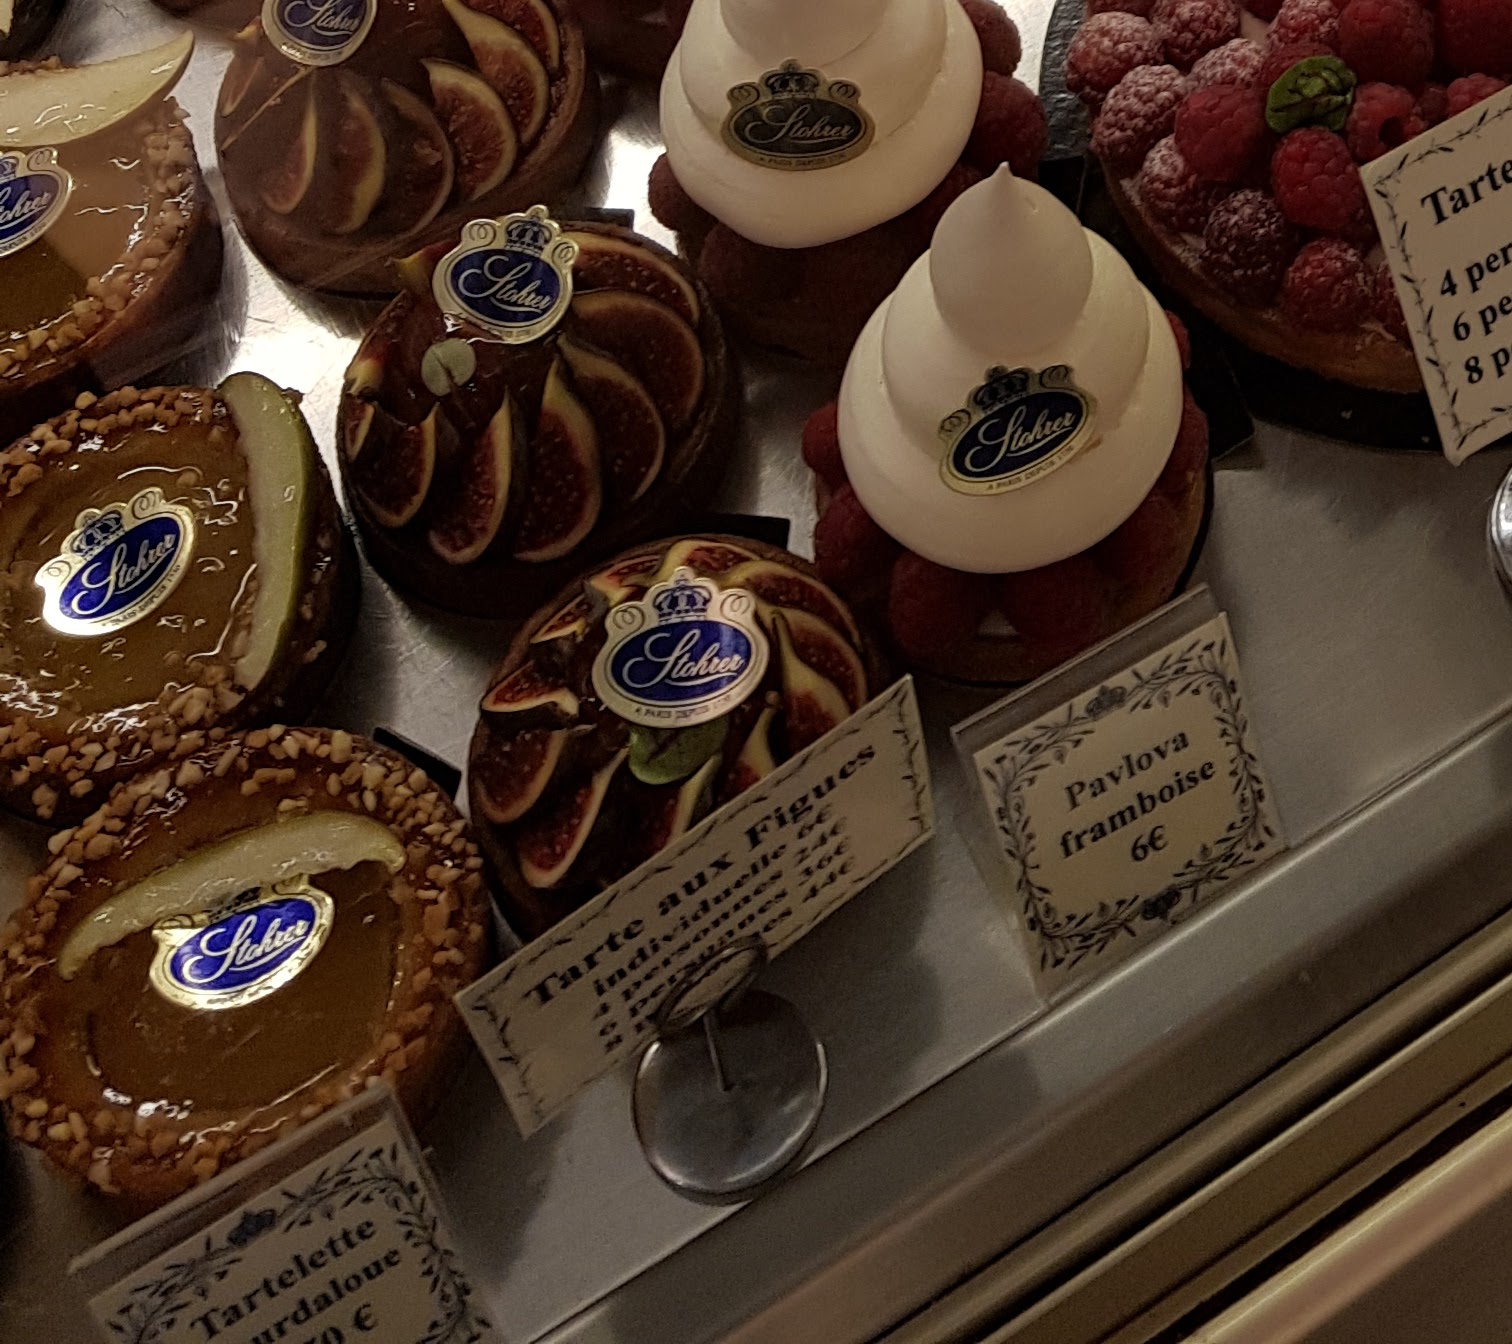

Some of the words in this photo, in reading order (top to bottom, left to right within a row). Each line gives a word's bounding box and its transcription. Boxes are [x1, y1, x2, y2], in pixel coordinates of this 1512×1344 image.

[743, 103, 855, 146] Stohrer
[0, 186, 52, 231] ohrer
[458, 254, 553, 314] Stohrer
[1440, 269, 1457, 297] 4
[1453, 311, 1471, 342] 6
[1464, 355, 1484, 385] 8
[965, 405, 1077, 473] Stohrer
[72, 532, 176, 616] Stohrer
[622, 629, 745, 688] Stohrer
[1064, 731, 1190, 812] Pavlova
[1060, 761, 1216, 860] framboise
[522, 918, 645, 1006] Tarte
[657, 851, 736, 916] aux
[744, 744, 876, 852] Figues
[1130, 824, 1169, 862] 6€
[182, 914, 312, 984] Stohrer
[188, 1219, 376, 1341] Tartelette
[251, 1248, 401, 1344] urdaloue
